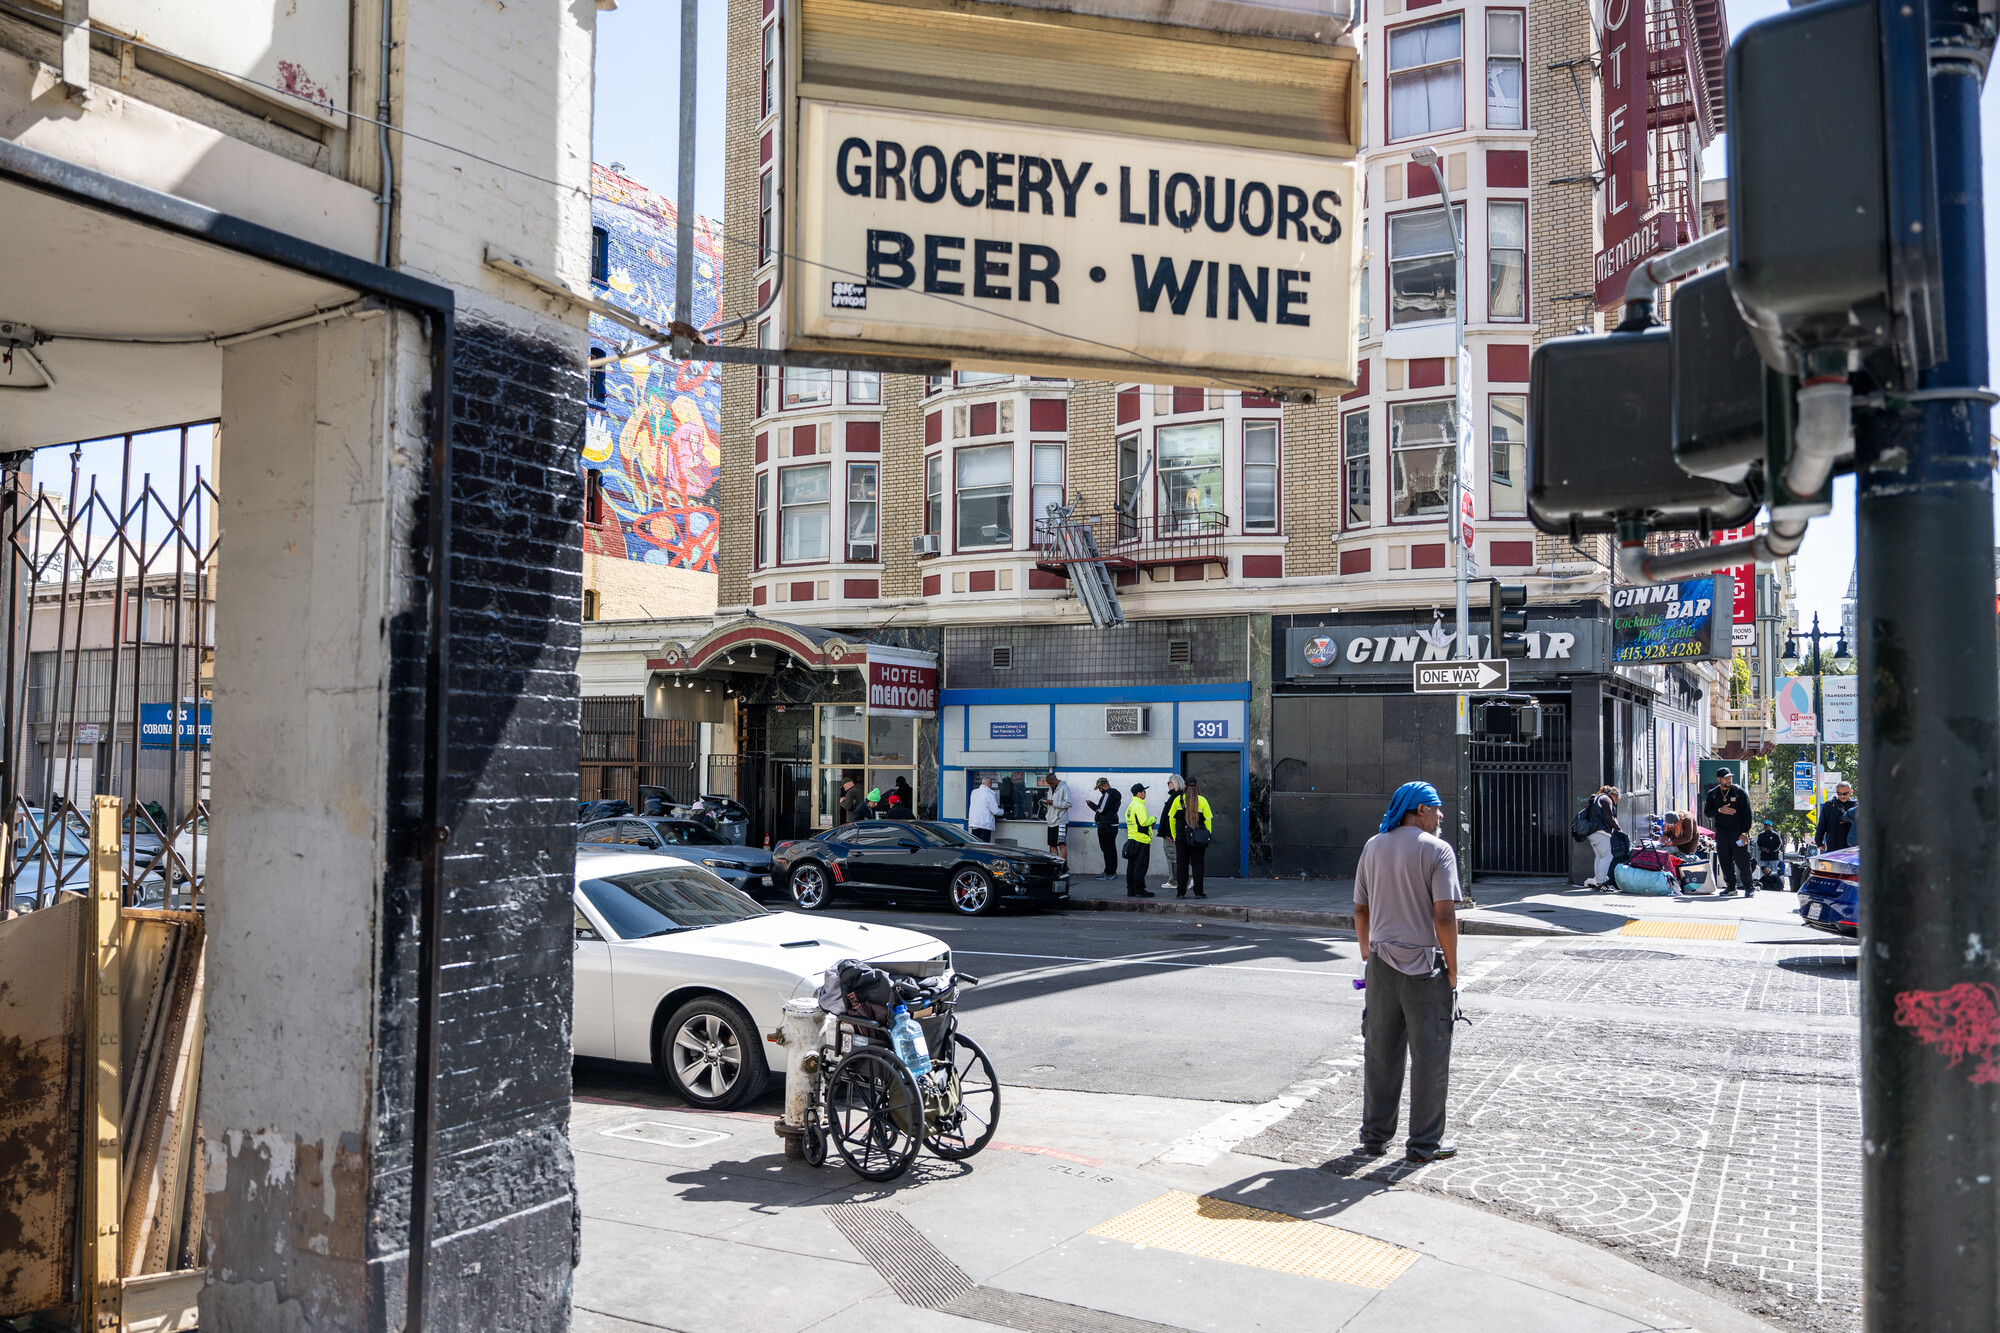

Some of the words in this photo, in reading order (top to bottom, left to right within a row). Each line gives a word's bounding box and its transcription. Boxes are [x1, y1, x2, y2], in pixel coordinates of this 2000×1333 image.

[837, 137, 1093, 218] GROCERY
[1120, 165, 1342, 244] LIQUORS
[1597, 219, 1659, 284] MENTONE
[866, 229, 1061, 305] BEER
[1131, 253, 1311, 327] WINE
[1614, 584, 1679, 608] CINNA
[1665, 598, 1711, 620] BAR
[1614, 613, 1662, 629] Cocktails
[1638, 628, 1661, 642] Pool
[1666, 626, 1696, 639] Table
[1621, 641, 1702, 660] 415.928.4288
[881, 666, 924, 684] HOTEL
[1422, 670, 1449, 683] ONE
[1452, 669, 1480, 682] WAY
[871, 684, 934, 708] MENTONE
[143, 724, 184, 735] CORONAO
[1196, 722, 1223, 737] 391
